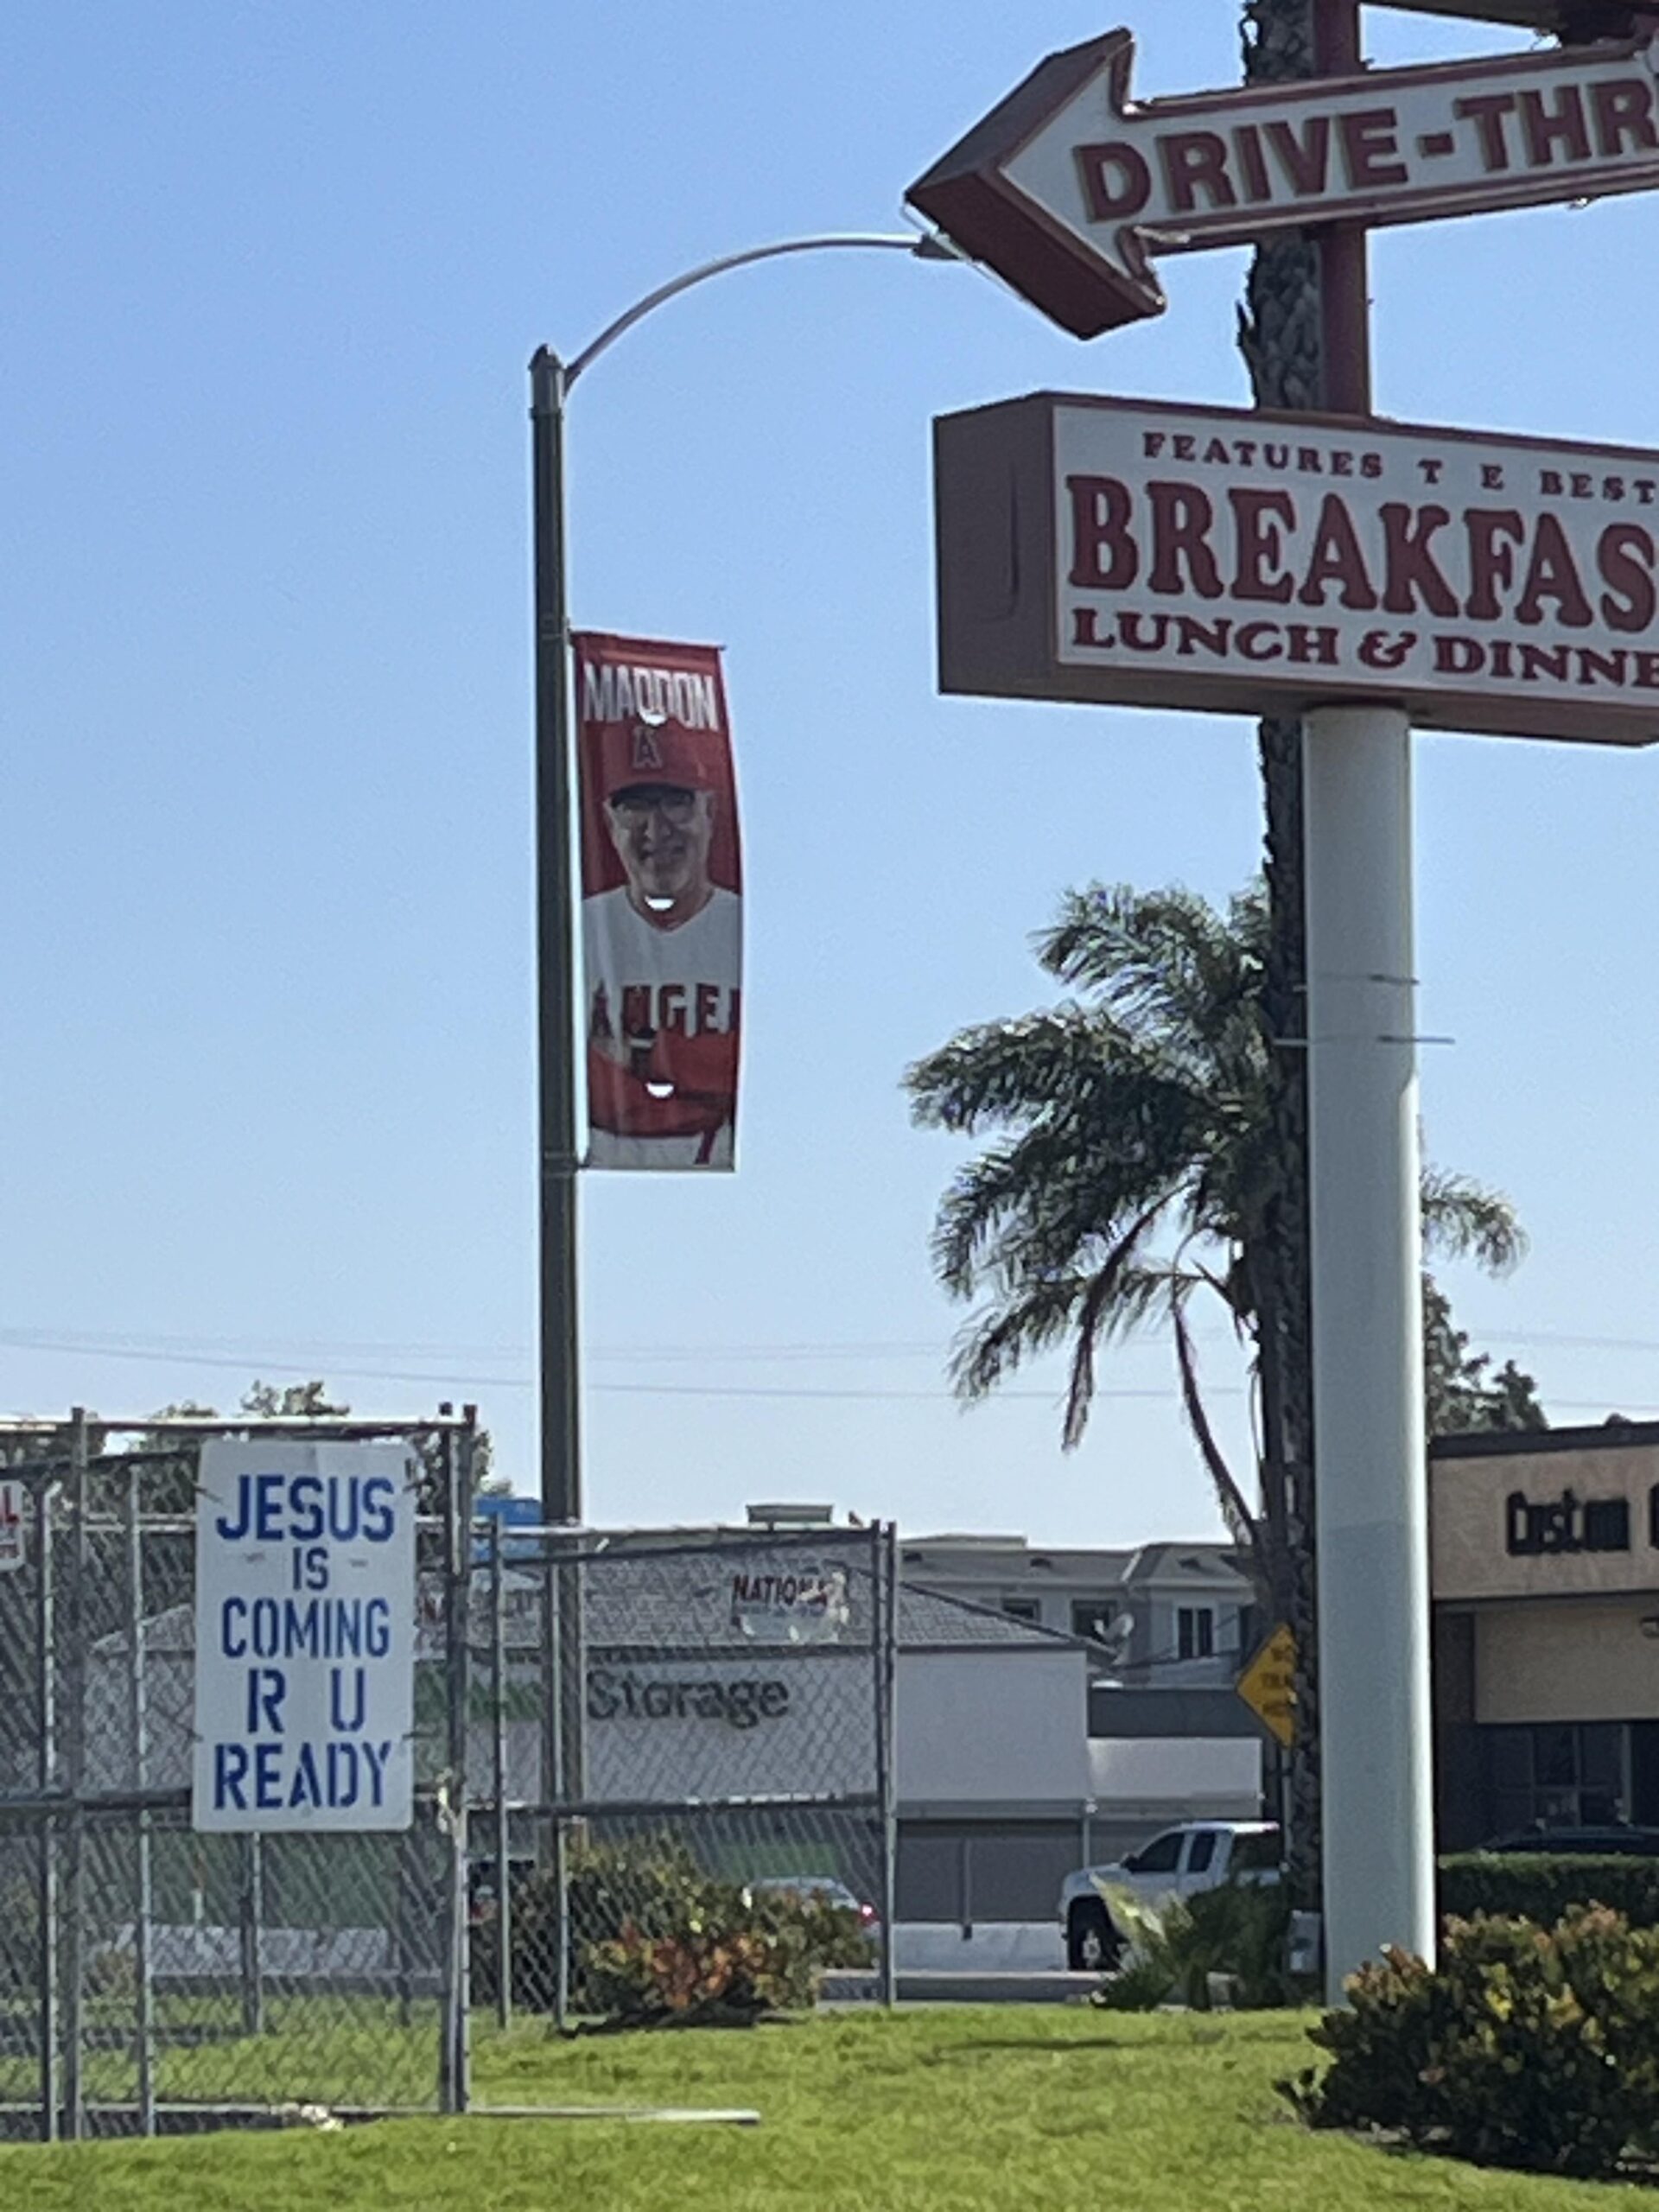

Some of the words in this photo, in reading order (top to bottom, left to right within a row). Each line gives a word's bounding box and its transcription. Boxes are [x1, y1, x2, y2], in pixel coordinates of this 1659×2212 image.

[1142, 431, 1383, 480] FEATURES
[1540, 469, 1657, 505] BEST
[1065, 474, 1657, 633] BREAKFAS
[1072, 607, 1338, 666] LUNCH
[1357, 630, 1417, 670] &
[582, 659, 720, 732] MADDON
[215, 1474, 396, 1542] JESUS
[292, 1547, 329, 1591] IS
[221, 1596, 391, 1659] COMING
[247, 1668, 287, 1734] R
[330, 1668, 365, 1732] U
[585, 1669, 789, 1730] Storage
[213, 1740, 392, 1812] READY
